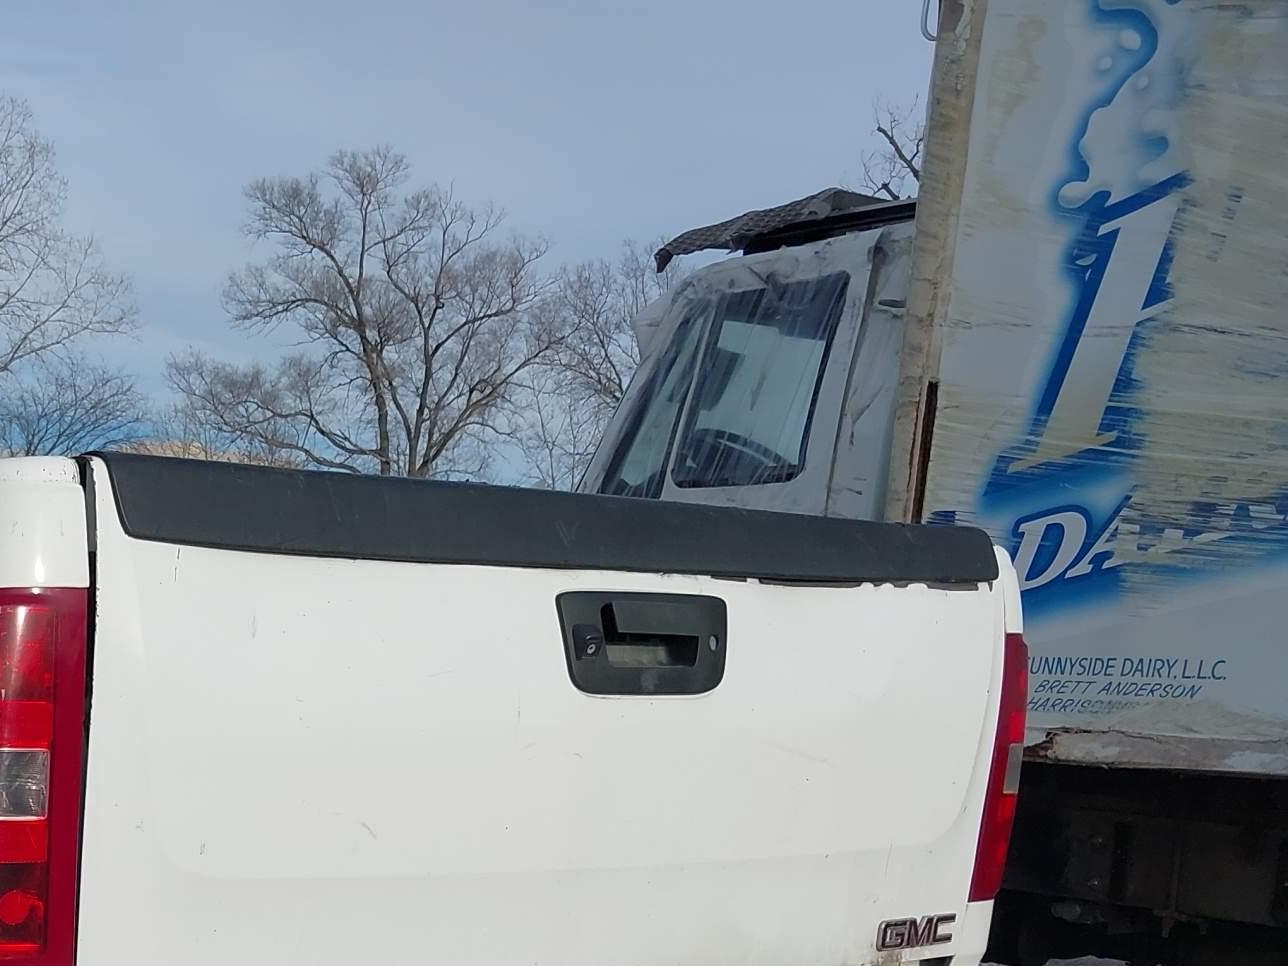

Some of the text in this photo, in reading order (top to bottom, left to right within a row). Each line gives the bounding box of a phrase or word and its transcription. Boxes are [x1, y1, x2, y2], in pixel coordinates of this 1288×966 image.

[1028, 656, 1116, 676] UNNYSIDE
[1181, 659, 1227, 681] L.L.C.
[1034, 679, 1202, 699] BRETT ANDERSON
[876, 913, 956, 952] GMC
